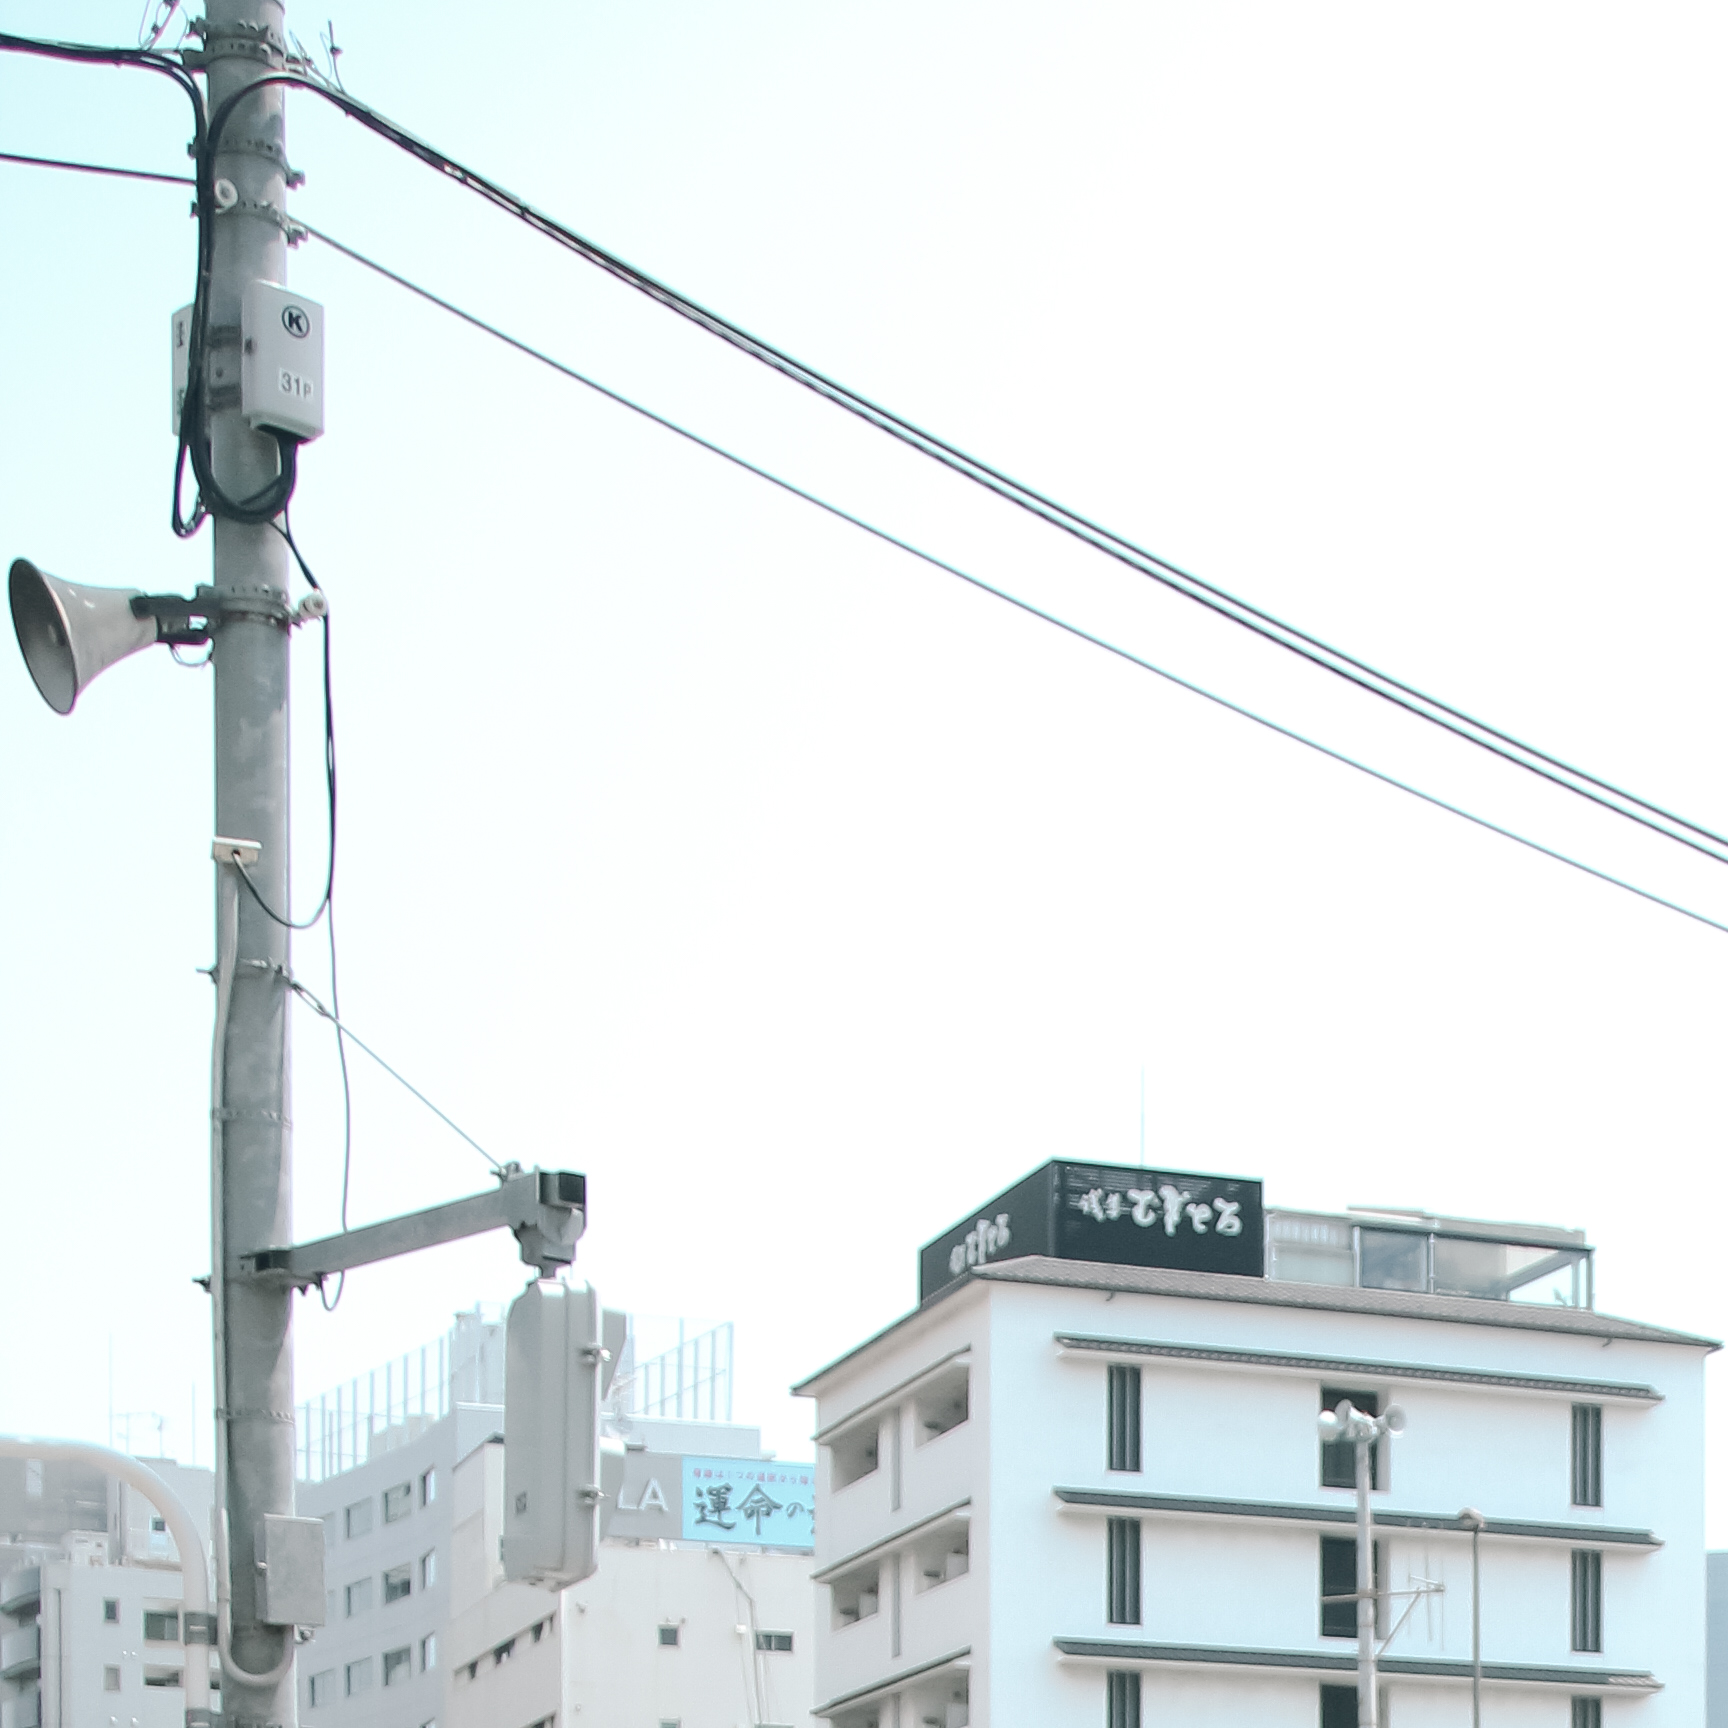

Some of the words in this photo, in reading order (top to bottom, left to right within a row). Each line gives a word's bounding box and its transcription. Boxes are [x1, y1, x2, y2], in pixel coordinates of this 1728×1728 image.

[285, 309, 307, 335] K
[693, 1482, 815, 1536] 運命の
